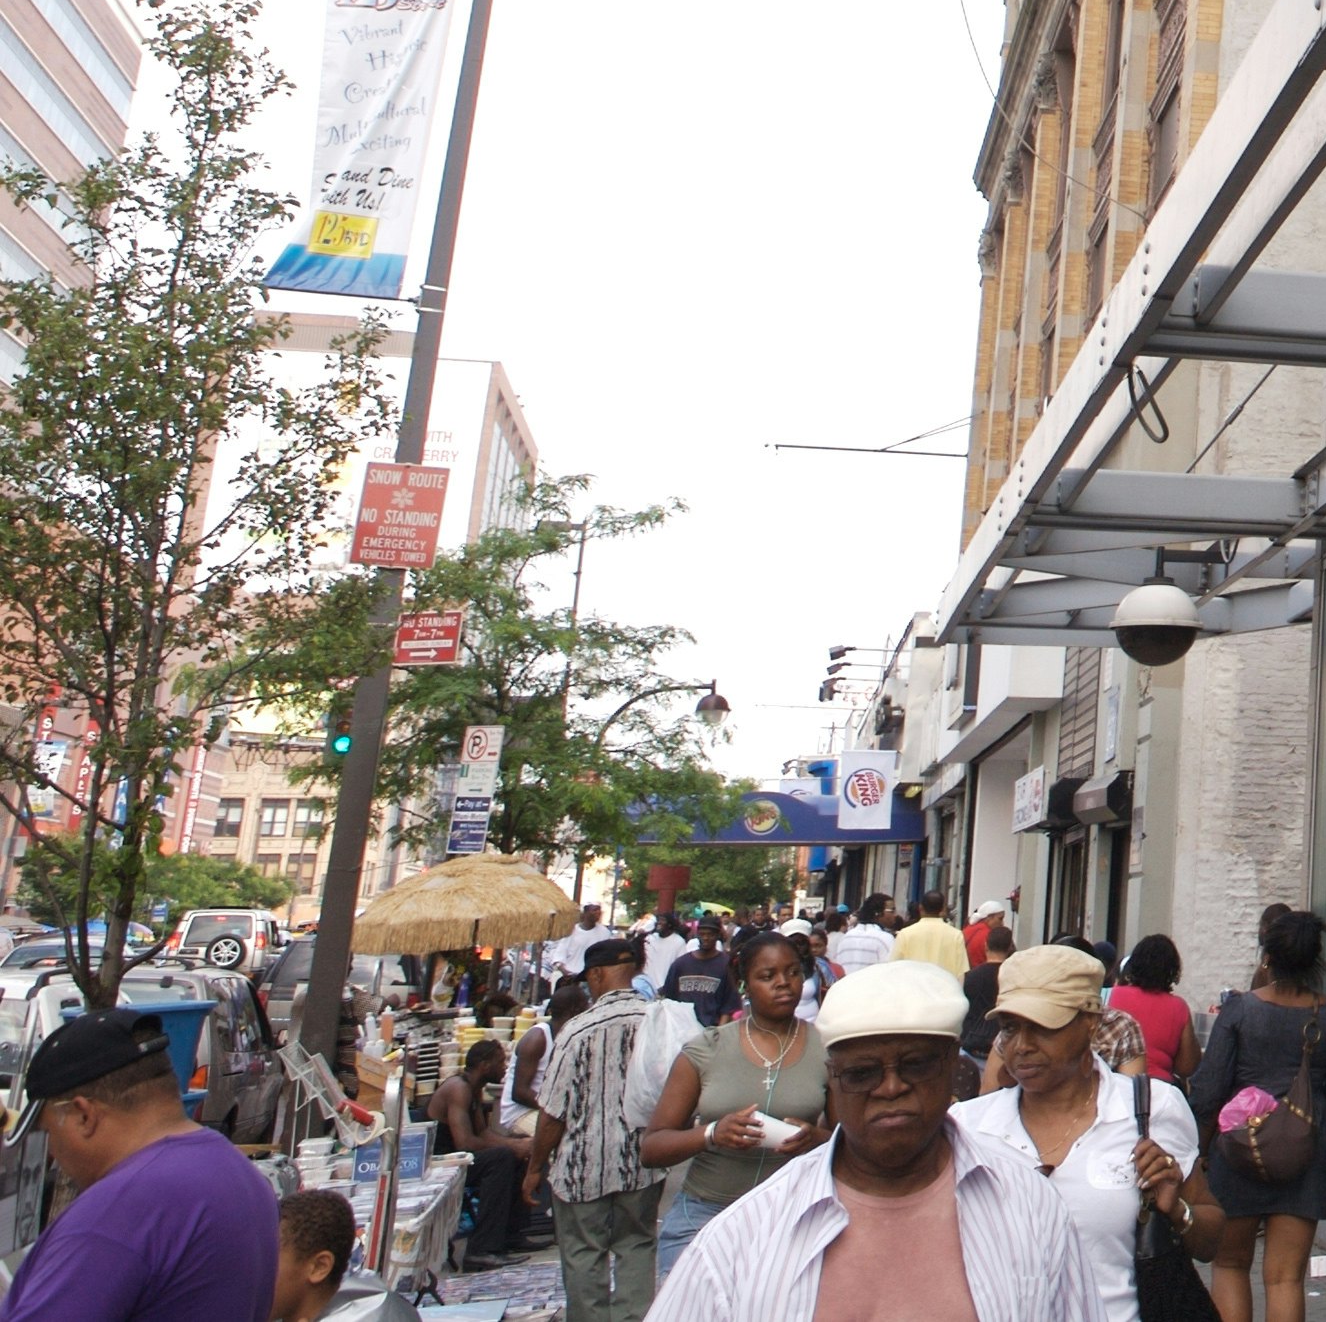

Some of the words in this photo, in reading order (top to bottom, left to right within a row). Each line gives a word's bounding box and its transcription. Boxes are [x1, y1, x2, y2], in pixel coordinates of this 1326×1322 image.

[337, 19, 404, 46] Vibrant
[341, 167, 375, 185] and
[377, 166, 415, 190] Dine
[374, 446, 460, 463] CRERRY
[368, 469, 403, 485] SNOW
[408, 472, 445, 489] ROUTE
[360, 507, 378, 523] NO
[384, 509, 438, 528] STANDING
[377, 525, 417, 538] DURING
[362, 537, 427, 550] EMERGENCY
[360, 548, 396, 561] VEHICLES
[400, 550, 427, 563] TOWED
[417, 616, 459, 628] STANDING
[71, 730, 98, 817] SAPLES
[854, 773, 873, 807] KING
[865, 771, 880, 805] BURGER
[358, 1162, 384, 1175] OBA
